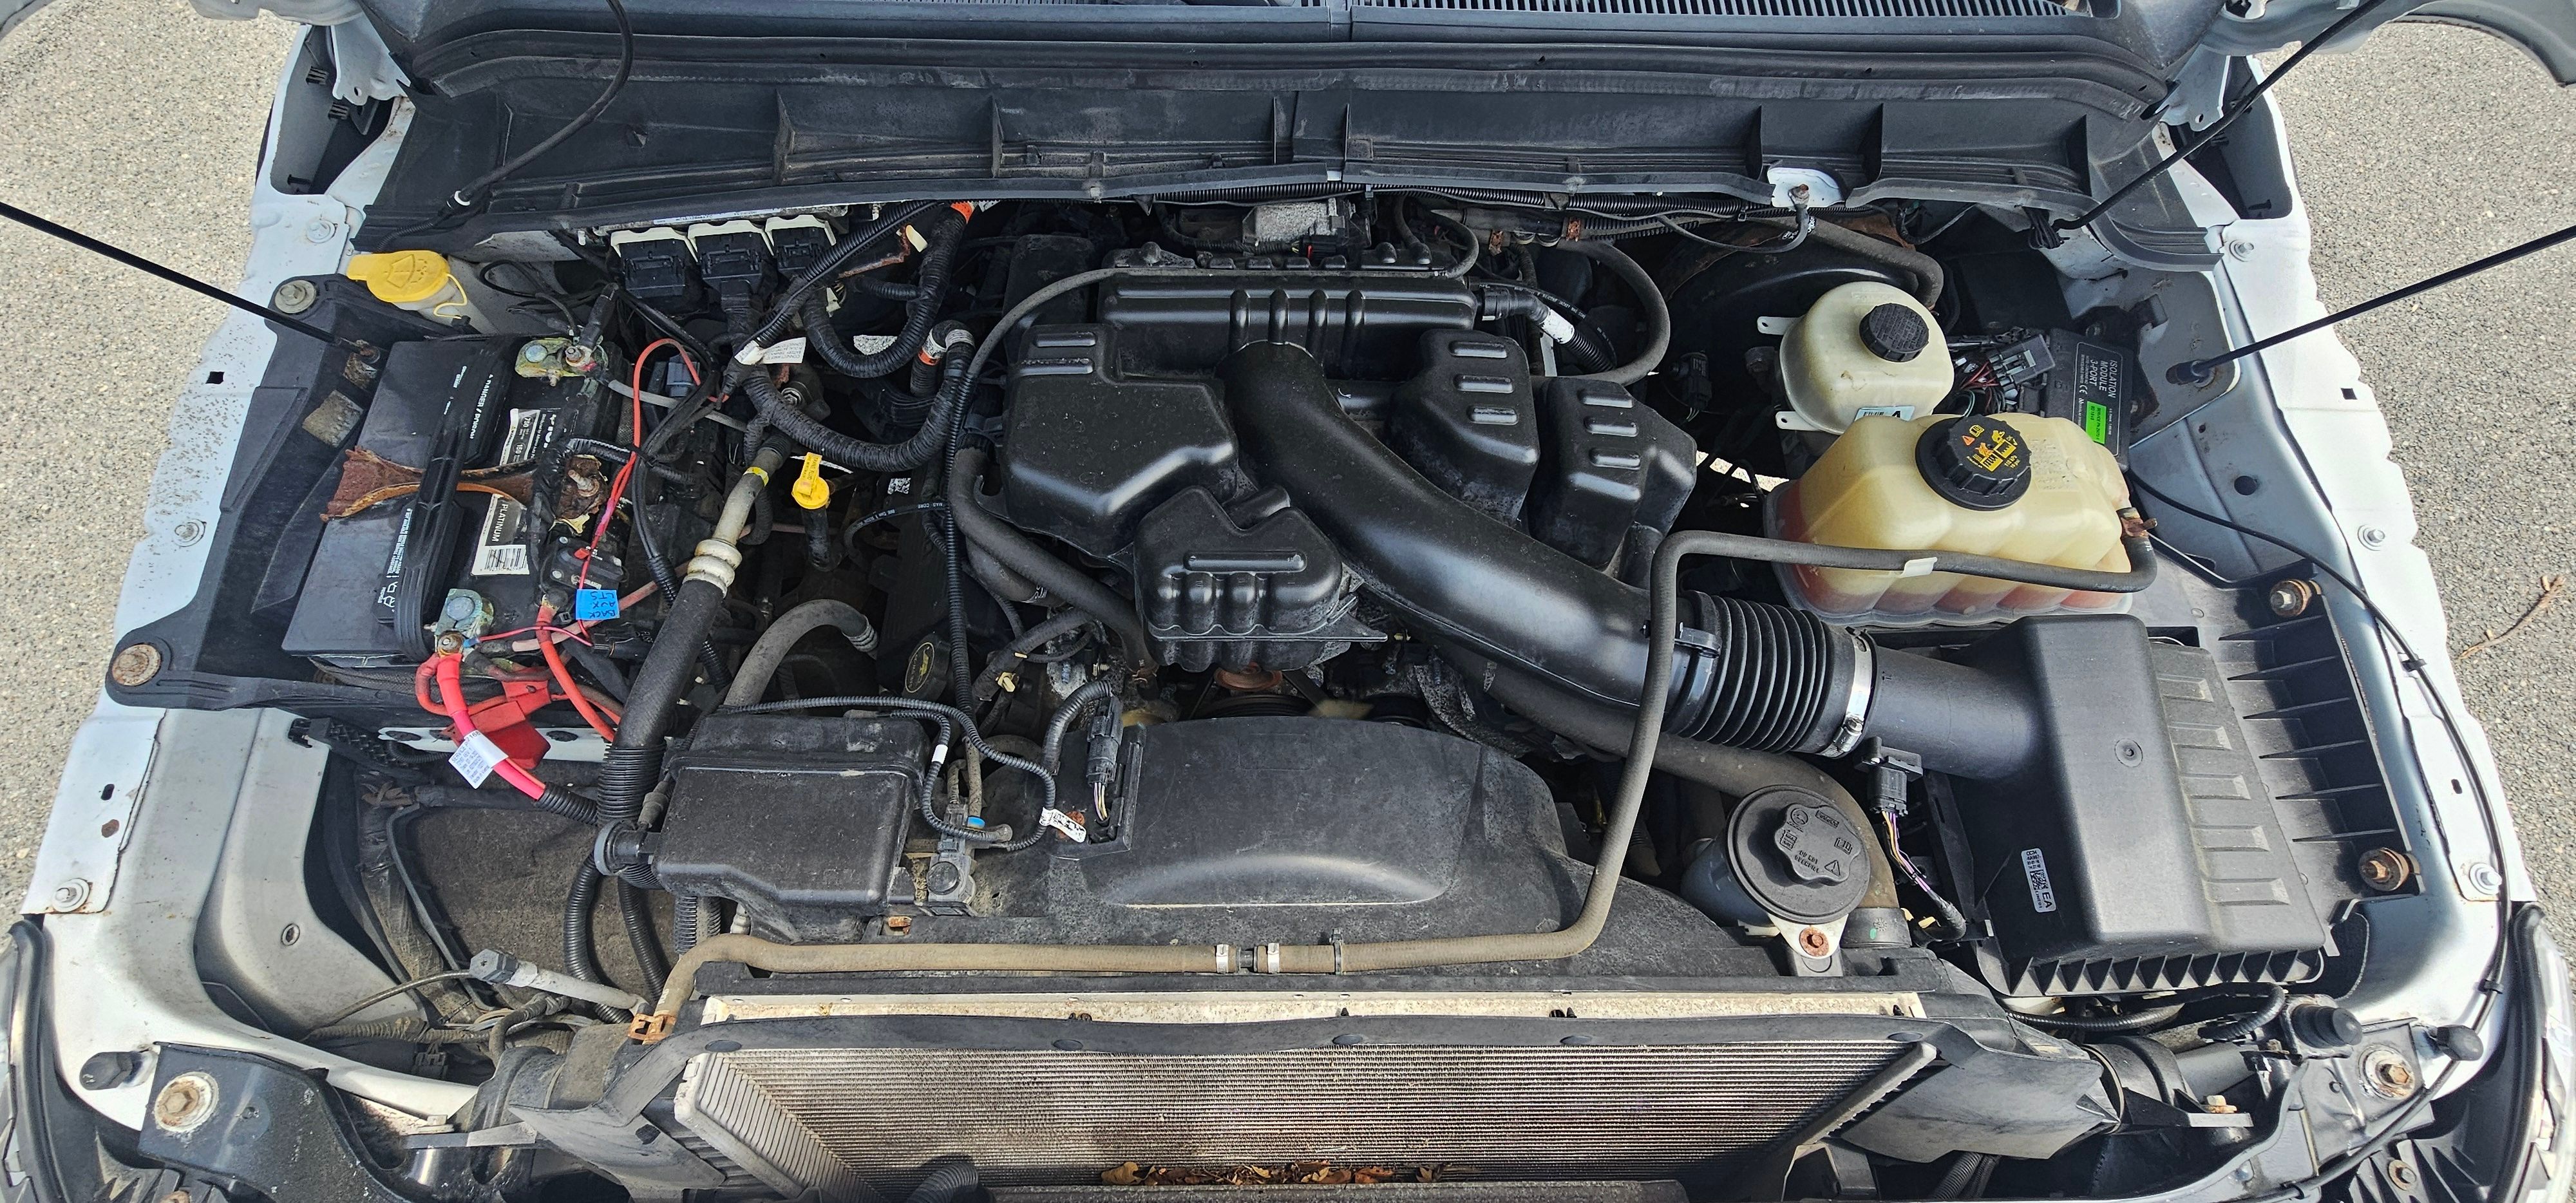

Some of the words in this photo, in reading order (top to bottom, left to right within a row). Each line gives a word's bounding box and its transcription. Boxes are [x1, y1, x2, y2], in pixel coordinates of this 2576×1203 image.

[2099, 361, 2108, 391] MODULE
[2108, 360, 2117, 397] ISOLATION
[491, 503, 509, 542] PLATINUM
[590, 591, 614, 600] LTS
[588, 610, 616, 618] BACK
[2042, 892, 2052, 907] EA
